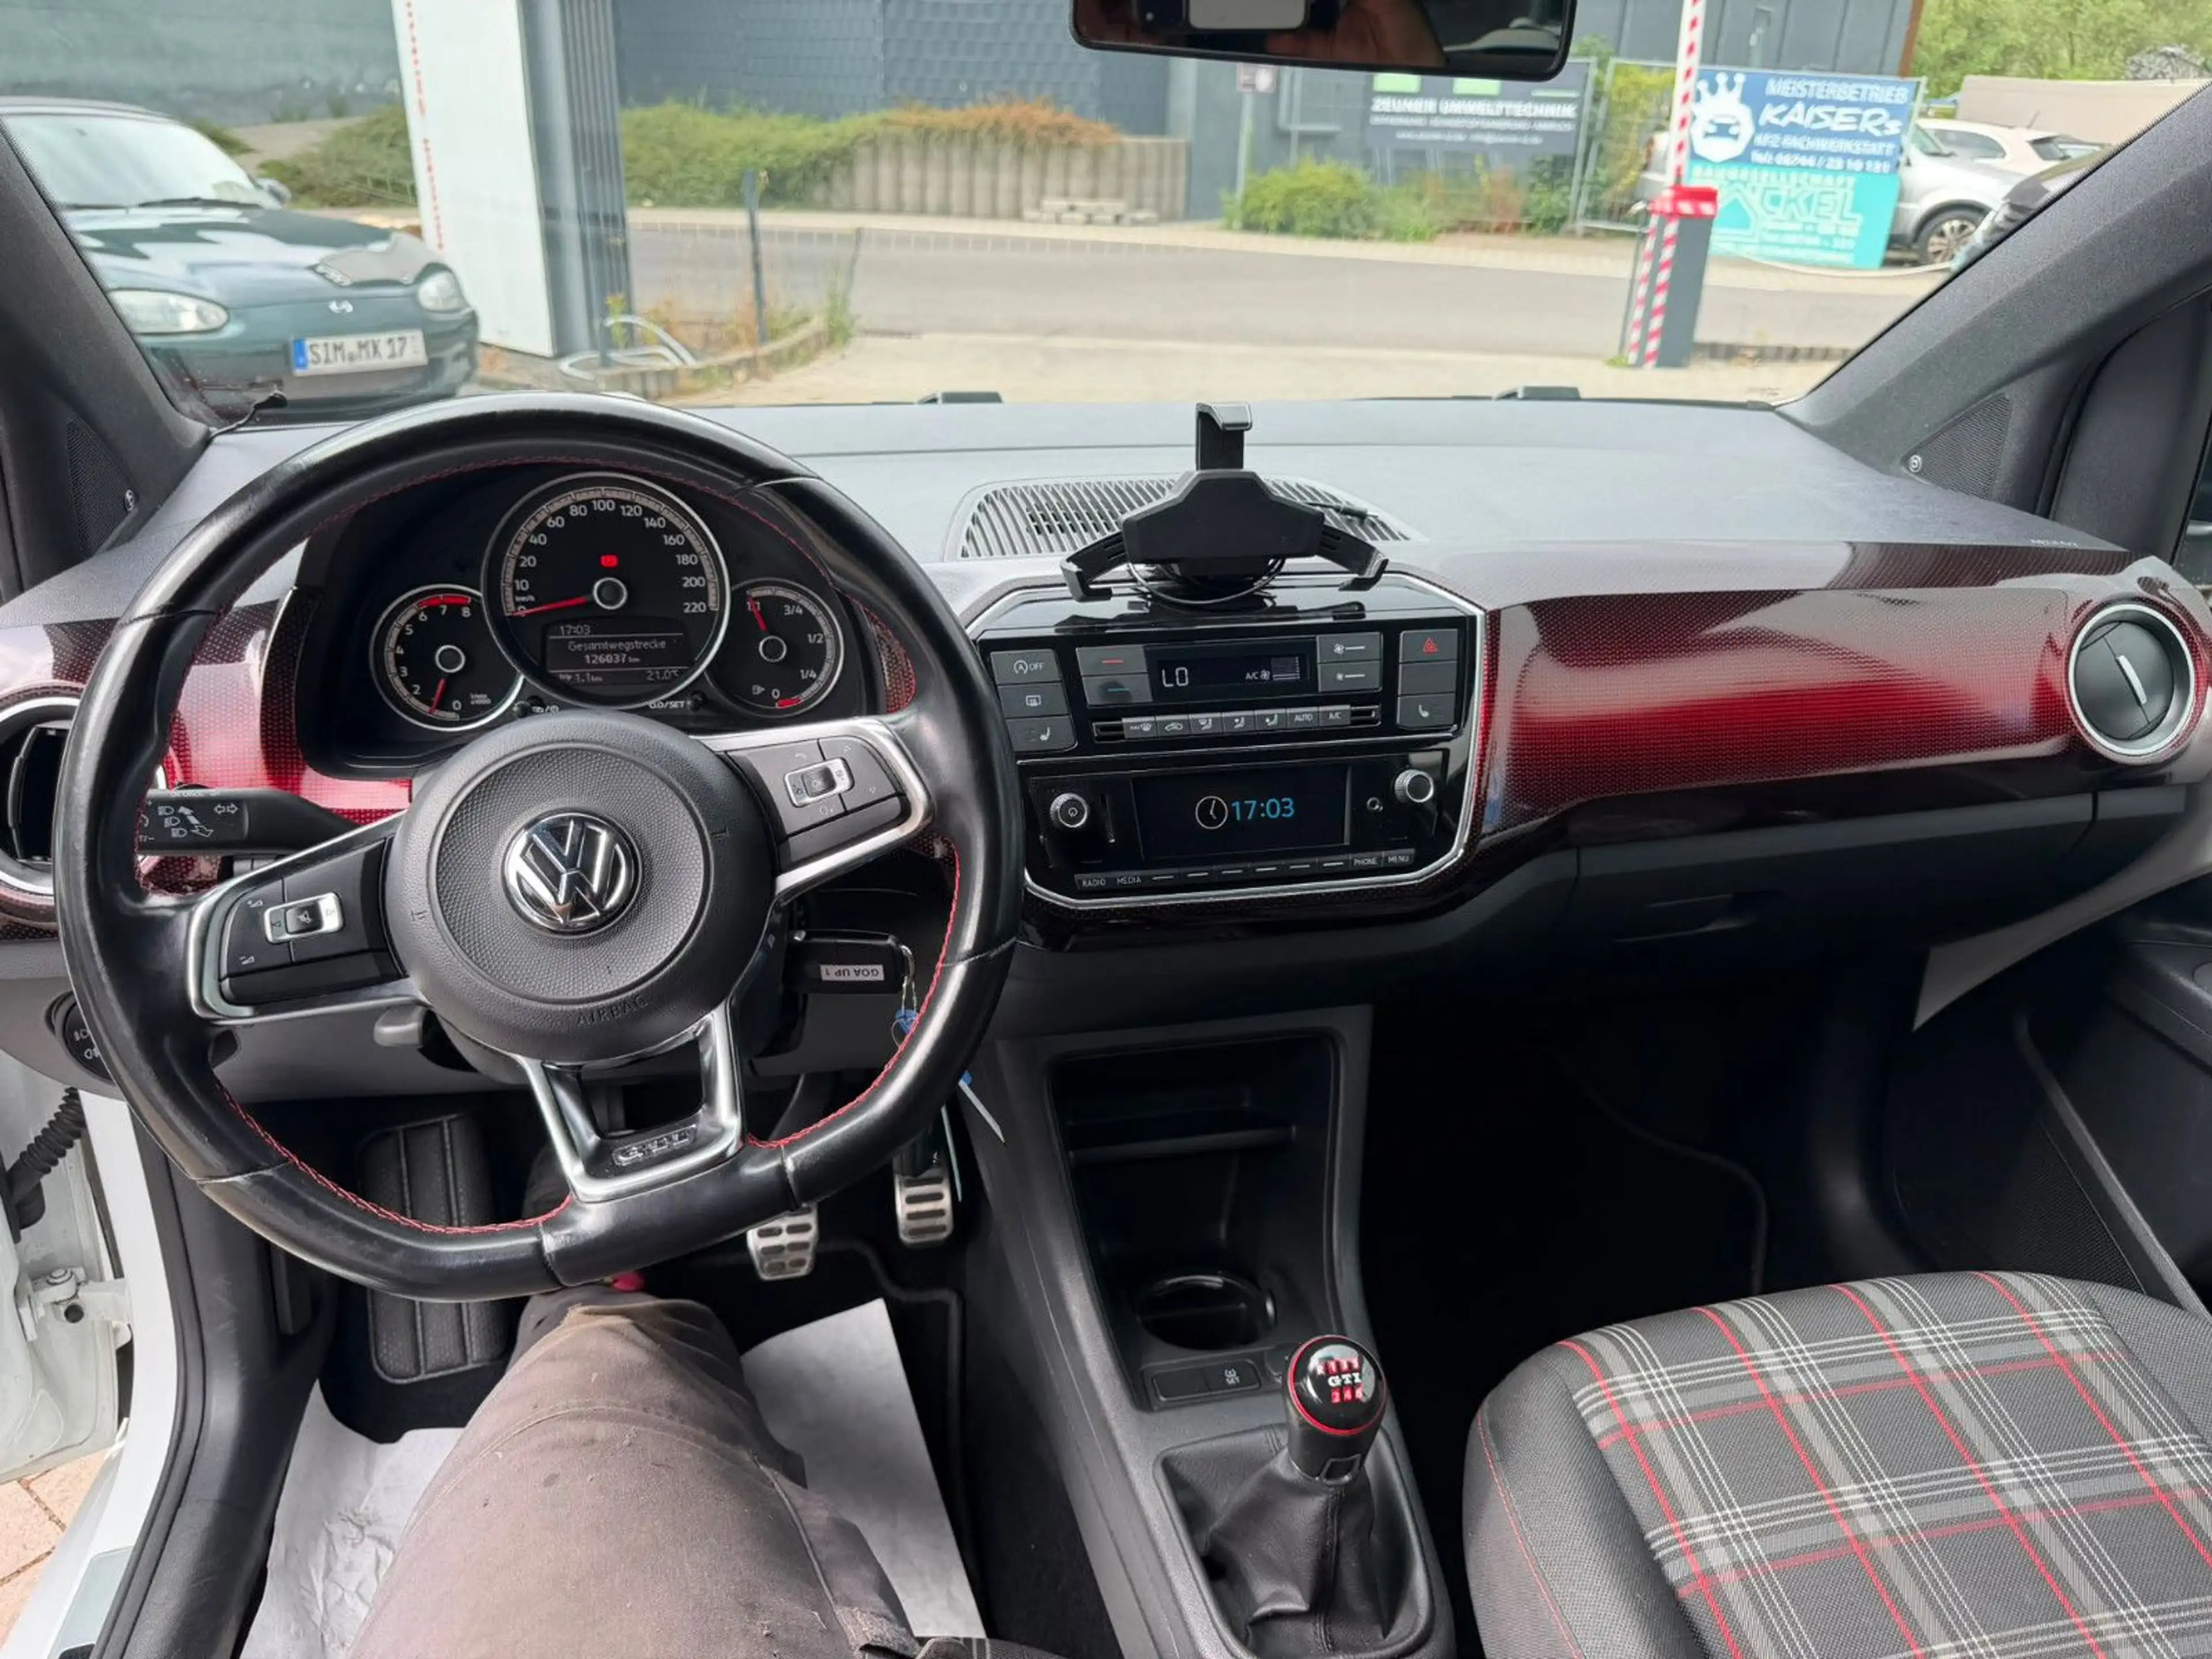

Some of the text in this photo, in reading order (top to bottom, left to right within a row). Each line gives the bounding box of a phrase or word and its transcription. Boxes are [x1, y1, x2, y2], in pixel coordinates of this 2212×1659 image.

[569, 505, 588, 517] 80
[593, 500, 615, 512] 100
[621, 505, 642, 517] 120
[548, 517, 565, 528] 60
[645, 518, 665, 529] 140
[529, 534, 547, 546] 40
[664, 535, 685, 546] 160
[520, 556, 537, 567] 20
[676, 554, 698, 565] 180
[514, 579, 529, 590] 10
[683, 577, 706, 588] 200
[440, 605, 447, 615] 7
[461, 607, 471, 618] 8
[684, 602, 706, 613] 220
[784, 605, 803, 615] 3/4
[419, 612, 428, 622] 6
[405, 624, 414, 635] 5
[559, 624, 590, 635] 17:03
[808, 634, 824, 643] 1/2
[396, 646, 404, 655] 4
[568, 640, 666, 652] Gesamtwegstrecke
[585, 654, 626, 664] 126037
[400, 666, 408, 677] 3
[1028, 663, 1044, 671] OFF
[800, 669, 816, 679] 1/4
[1245, 672, 1259, 680] A/C
[412, 684, 421, 695] 2
[771, 689, 781, 699] 0
[452, 700, 461, 710] 0
[1294, 713, 1313, 722] AUTO
[1328, 712, 1342, 720] A/C
[1231, 797, 1296, 821] 17:03
[1353, 857, 1379, 867] PHONE
[1387, 854, 1410, 864] MENU
[1082, 877, 1107, 888] RADIO
[1116, 874, 1142, 885] MEDIA
[835, 968, 851, 976] UP
[854, 968, 880, 977] GOA
[576, 995, 650, 1028] AIRBAG
[1327, 1372, 1362, 1388] GTI
